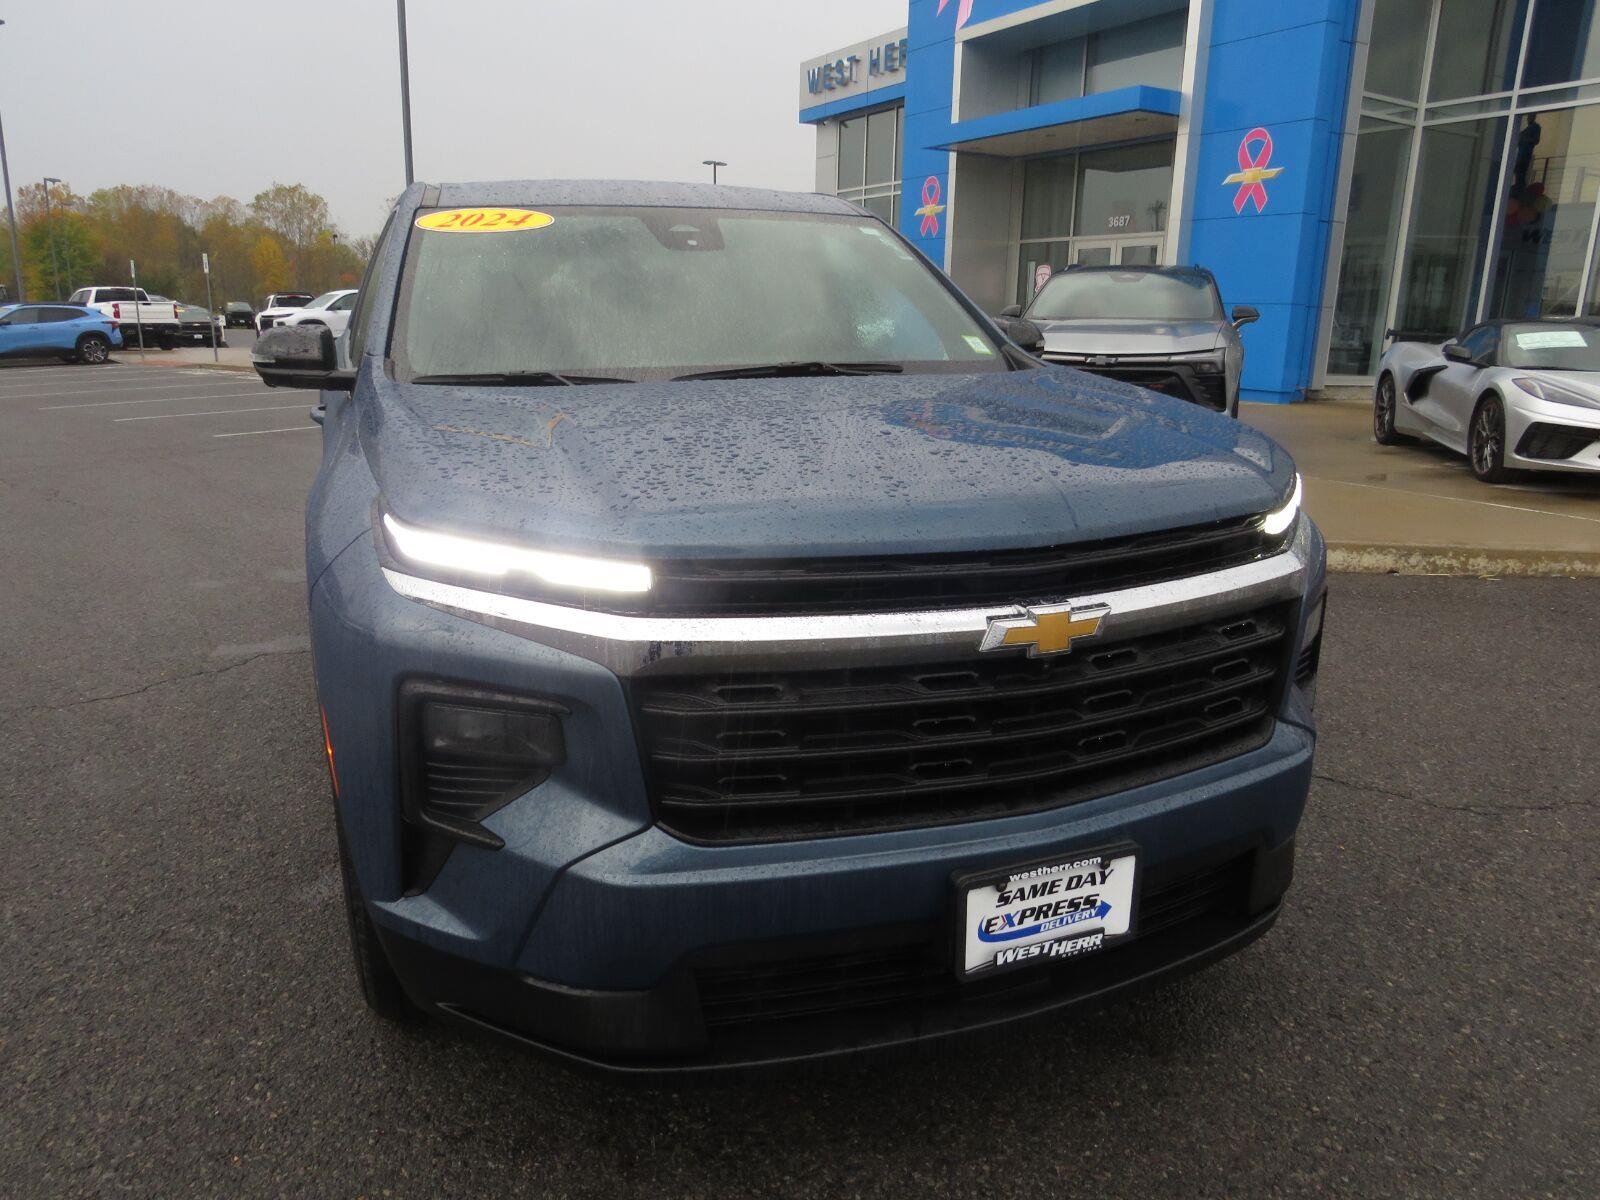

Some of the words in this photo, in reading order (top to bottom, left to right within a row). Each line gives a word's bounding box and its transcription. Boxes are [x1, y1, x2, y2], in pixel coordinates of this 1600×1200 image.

[807, 55, 860, 94] WEST
[435, 213, 533, 228] 2024
[1108, 215, 1130, 228] 3687
[1009, 856, 1101, 882] westherr.com
[996, 879, 1063, 908] SAME
[1065, 869, 1114, 893] DAY
[984, 894, 1100, 934] EXPRESS
[1039, 907, 1099, 933] DELIVERY
